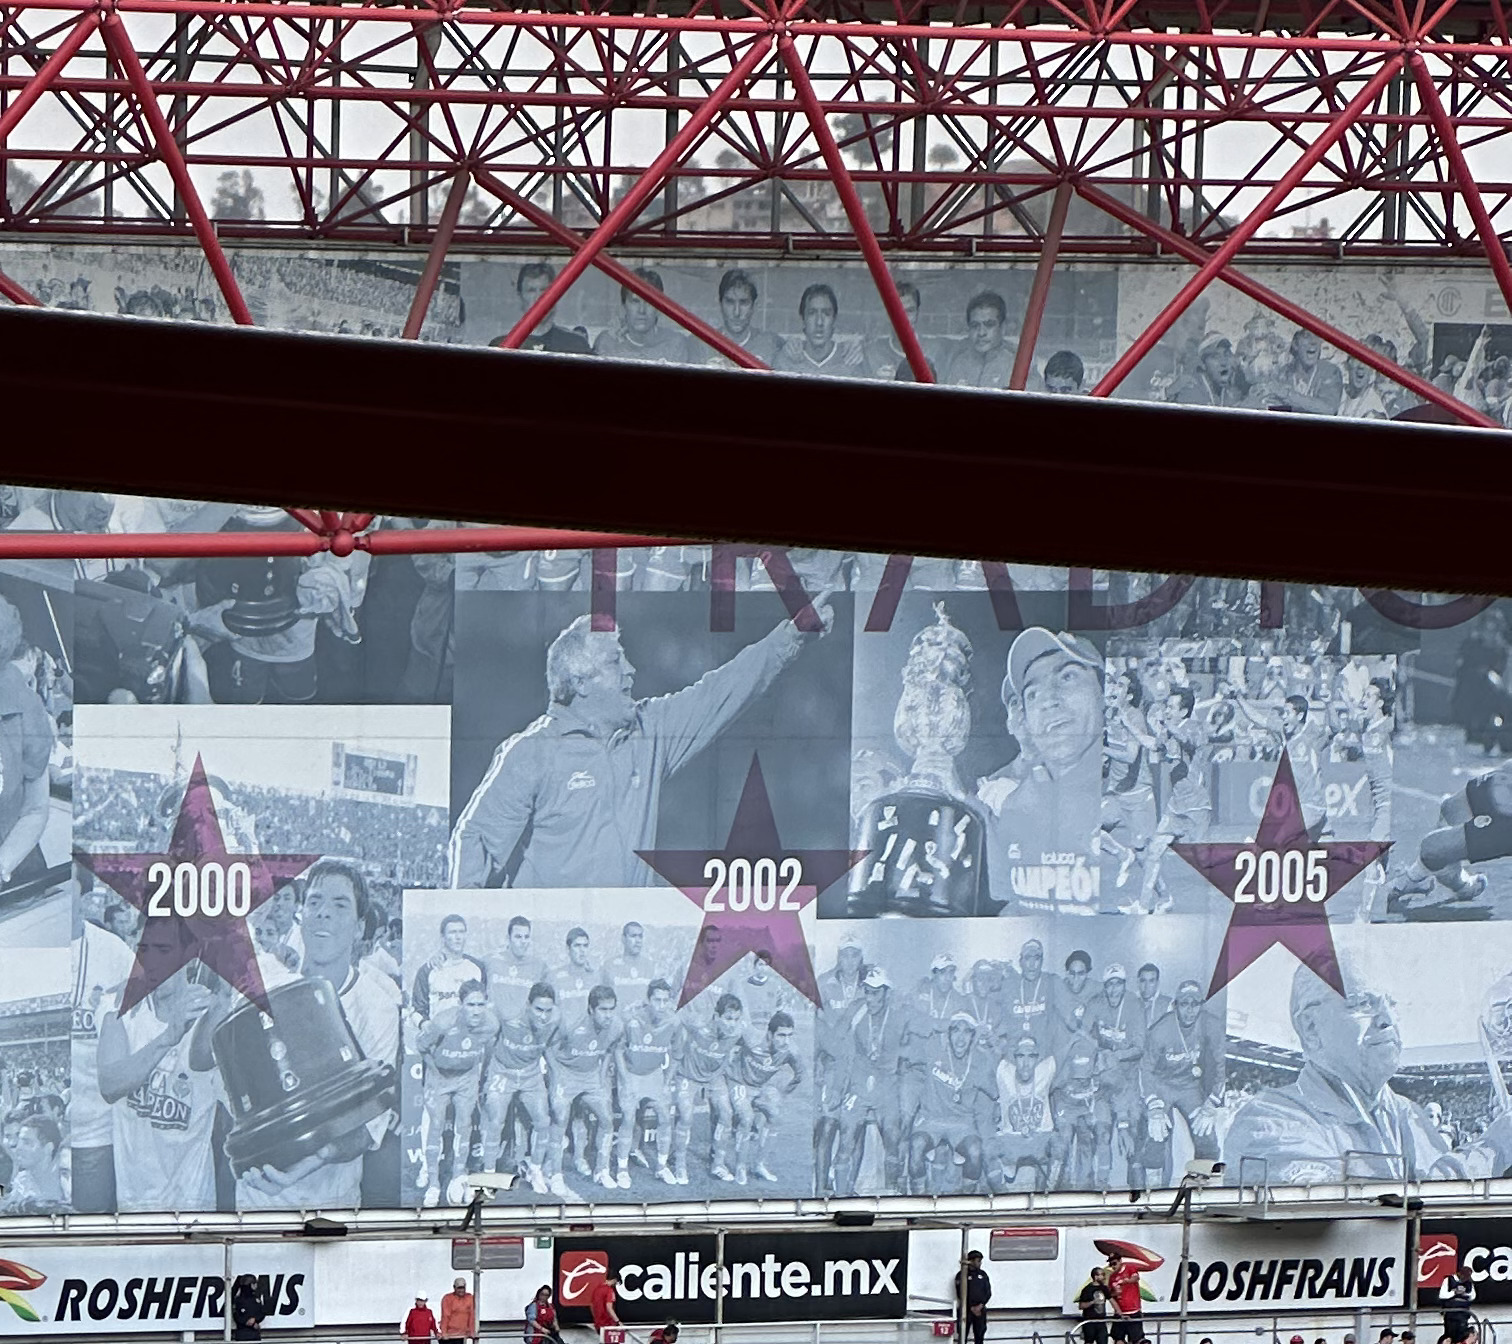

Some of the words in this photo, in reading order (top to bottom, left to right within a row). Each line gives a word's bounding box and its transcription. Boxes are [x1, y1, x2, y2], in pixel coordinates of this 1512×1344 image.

[146, 862, 252, 918] 2000
[702, 858, 803, 912] 2002
[1234, 850, 1329, 903] 2005
[53, 1273, 305, 1322] ROSHFRNS
[616, 1251, 900, 1301] caliente.mx
[1169, 1256, 1396, 1303] ROSHFRANS
